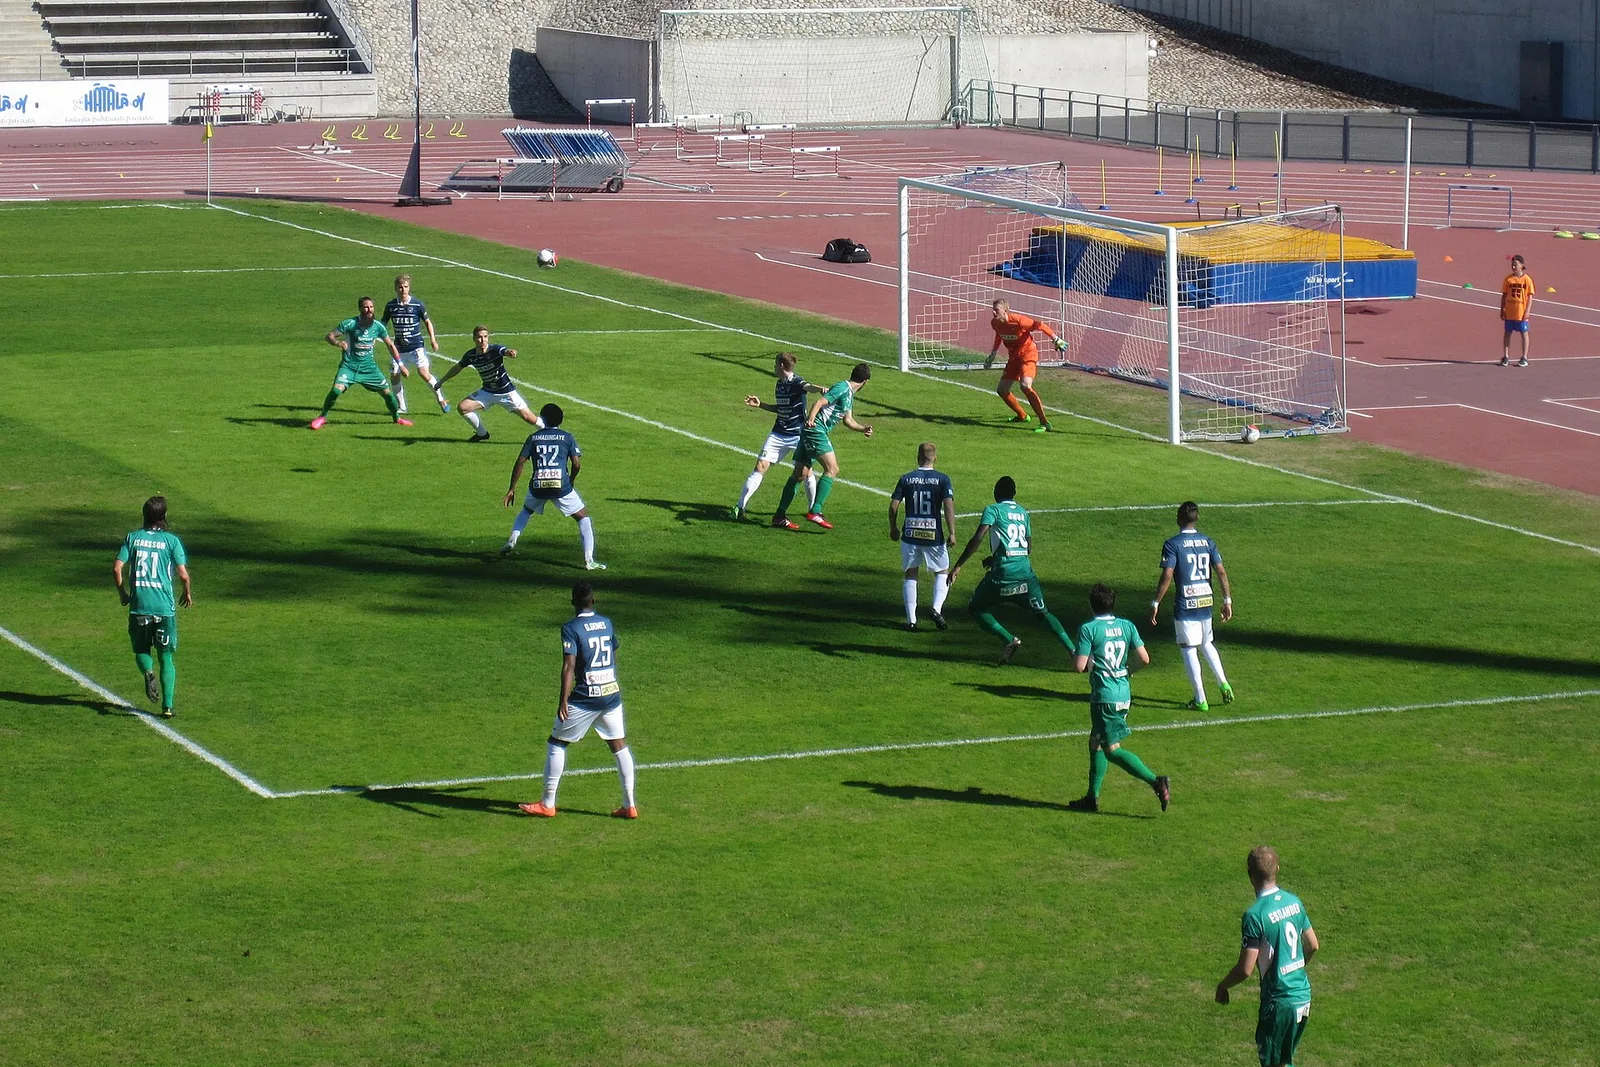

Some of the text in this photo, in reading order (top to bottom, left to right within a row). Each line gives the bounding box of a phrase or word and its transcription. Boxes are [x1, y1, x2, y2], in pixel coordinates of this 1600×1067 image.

[536, 445, 559, 467] 32
[912, 490, 932, 515] 16
[1007, 523, 1029, 548] 28
[135, 550, 158, 579] 31
[1187, 553, 1210, 581] 29
[588, 635, 611, 668] 25
[1285, 921, 1298, 960] 9
